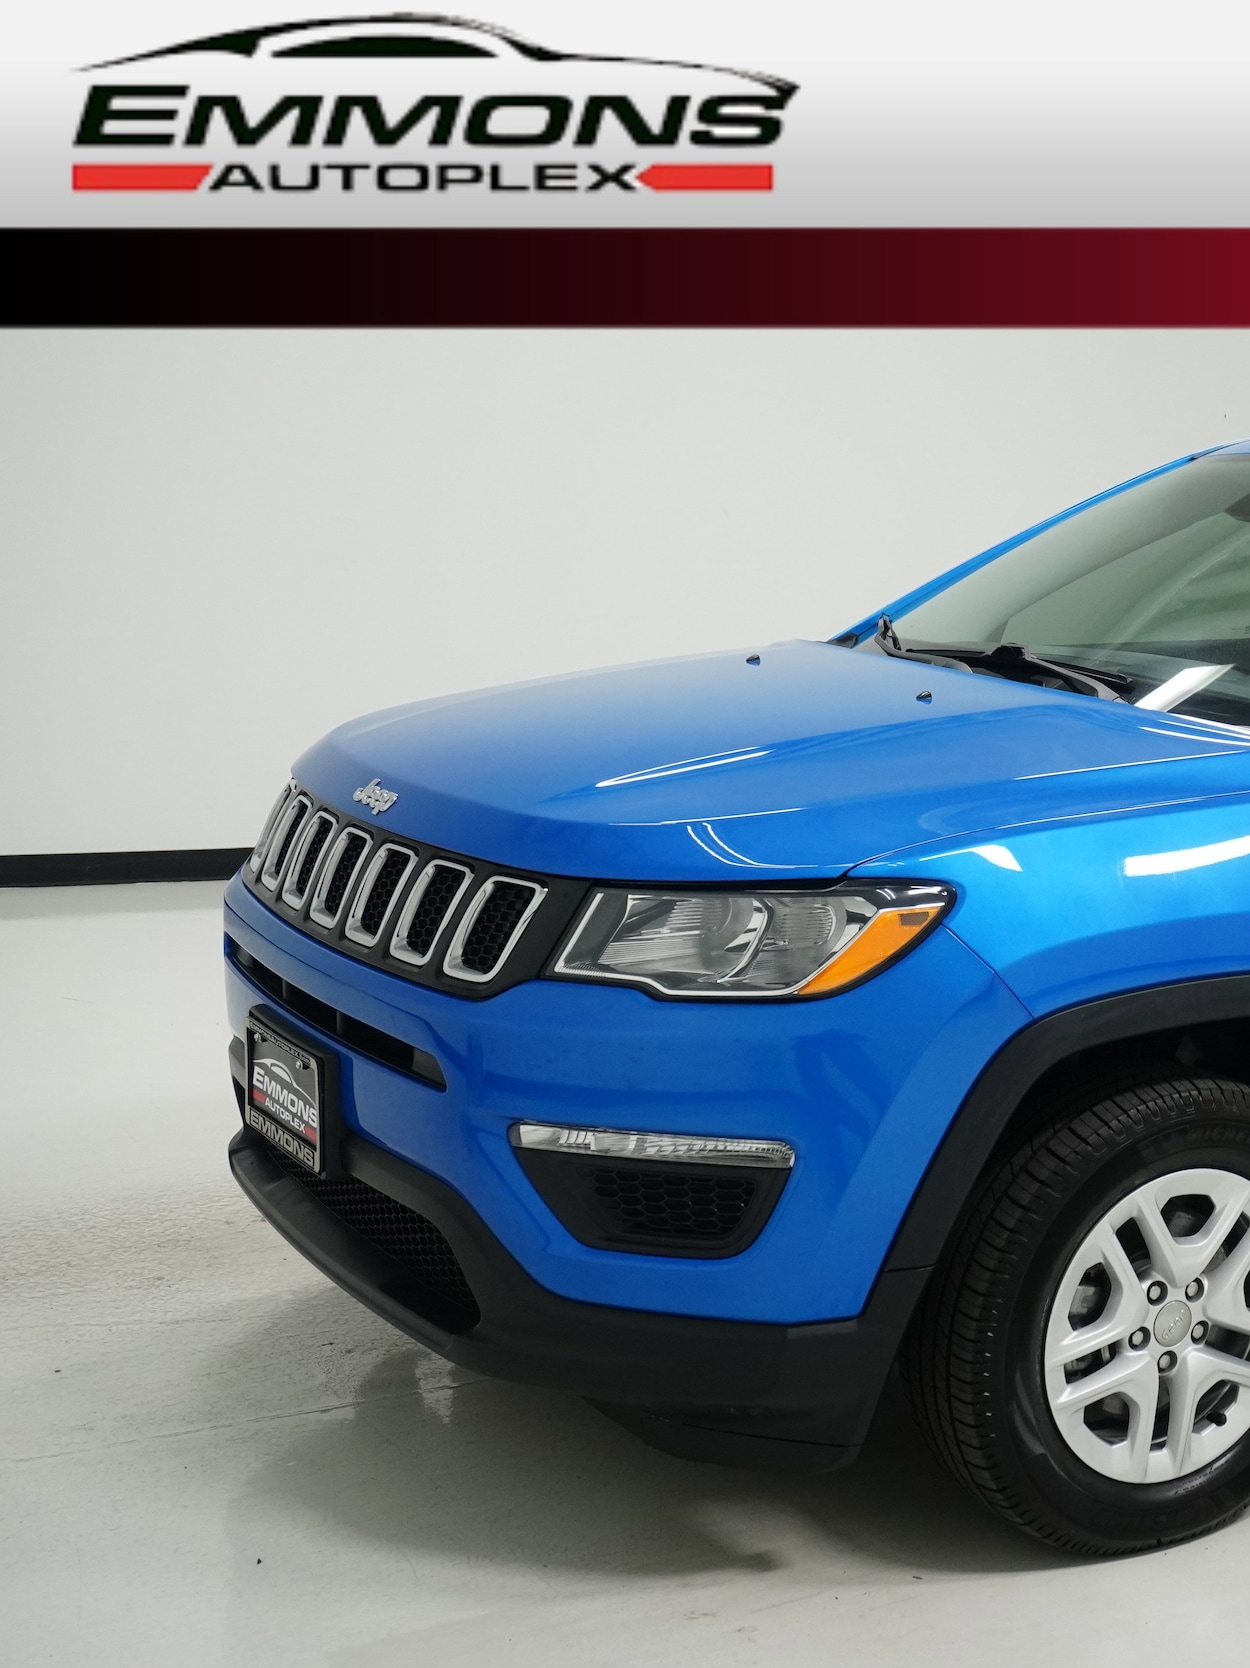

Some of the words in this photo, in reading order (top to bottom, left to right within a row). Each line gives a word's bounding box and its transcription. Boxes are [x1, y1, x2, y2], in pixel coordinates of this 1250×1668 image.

[353, 778, 399, 816] Jeep
[252, 1065, 318, 1129] EMMONS
[265, 1097, 306, 1134] AUTOPLEX
[250, 1109, 315, 1168] EMMONS
